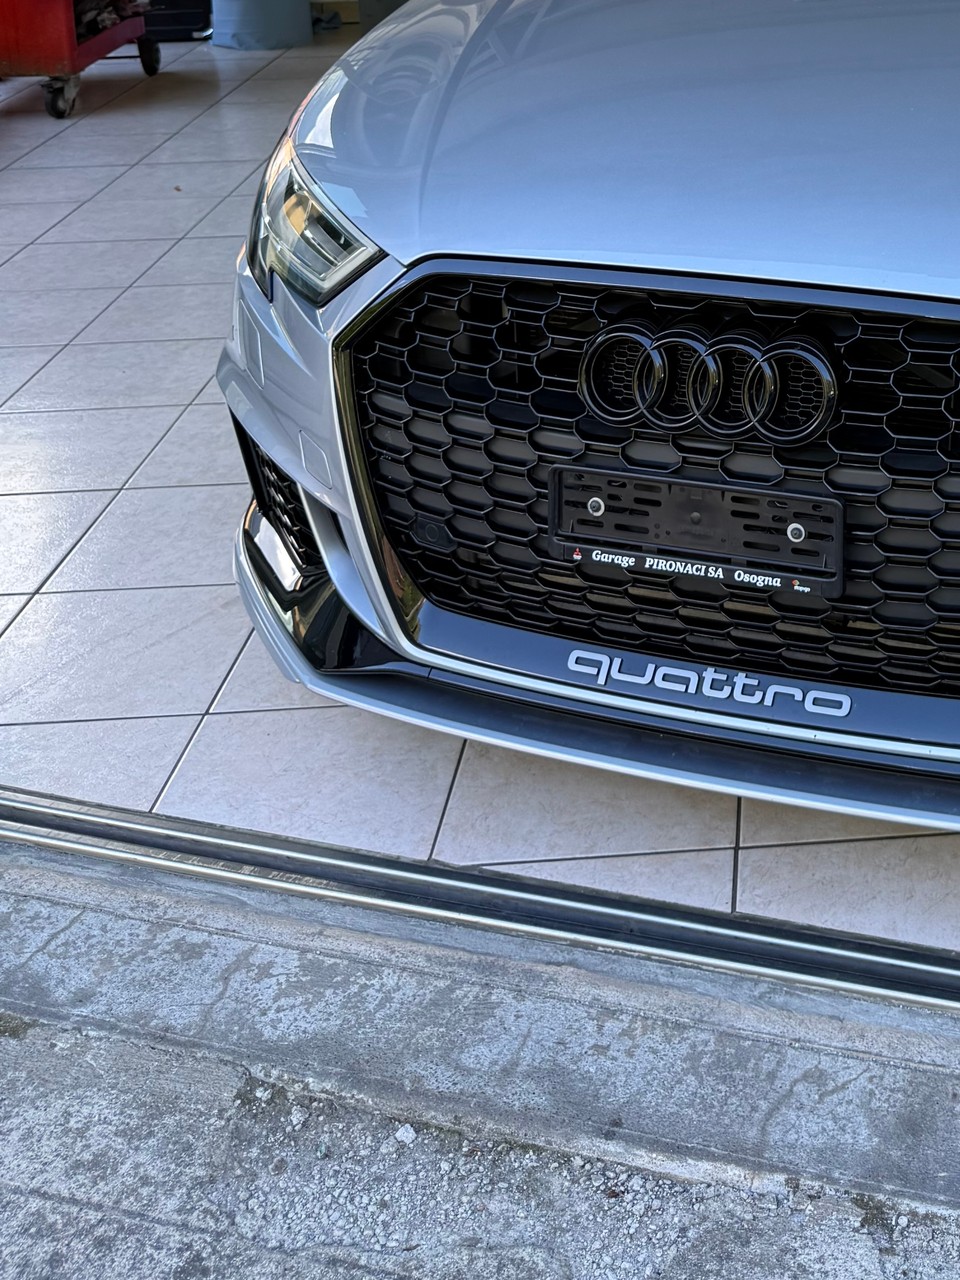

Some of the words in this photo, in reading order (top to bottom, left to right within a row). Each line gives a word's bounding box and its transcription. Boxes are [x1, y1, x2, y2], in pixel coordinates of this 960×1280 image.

[592, 550, 636, 568] Garage
[645, 557, 706, 576] PIRONACI
[707, 567, 724, 579] SA
[734, 570, 782, 587] Osogna
[567, 649, 852, 717] quattro
